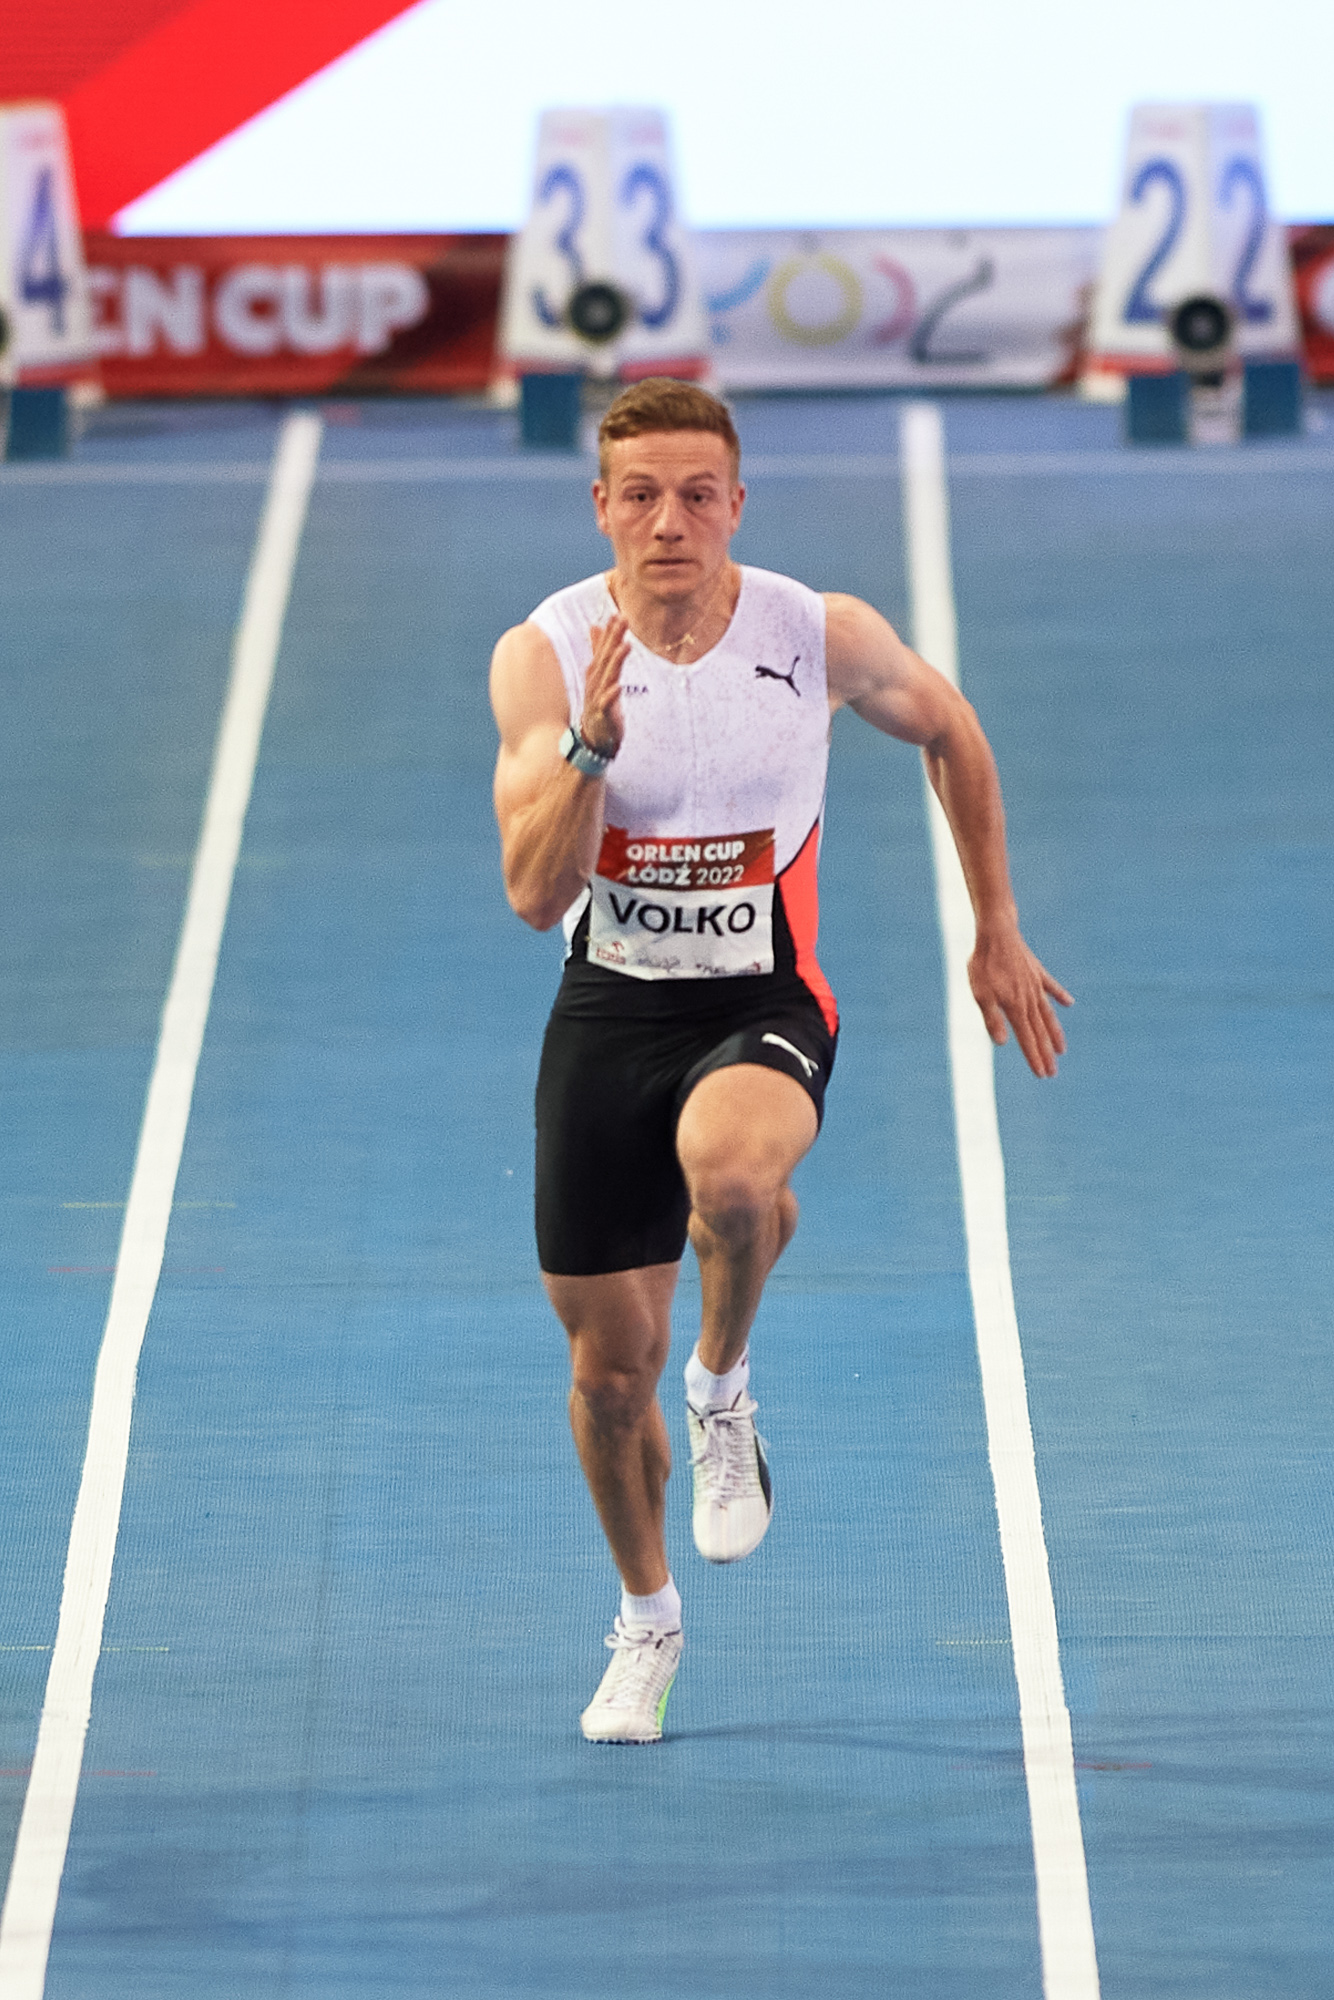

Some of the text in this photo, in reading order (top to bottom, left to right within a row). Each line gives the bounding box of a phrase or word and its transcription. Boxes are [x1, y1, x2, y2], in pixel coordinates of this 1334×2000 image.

[19, 162, 69, 337] 4
[619, 161, 682, 330] 3
[1120, 156, 1187, 324] 2
[1217, 156, 1273, 324] 2
[214, 262, 430, 358] CUP
[608, 891, 756, 937] VOLKO
[626, 840, 745, 863] ORLEN CUP
[696, 864, 745, 885] 2022
